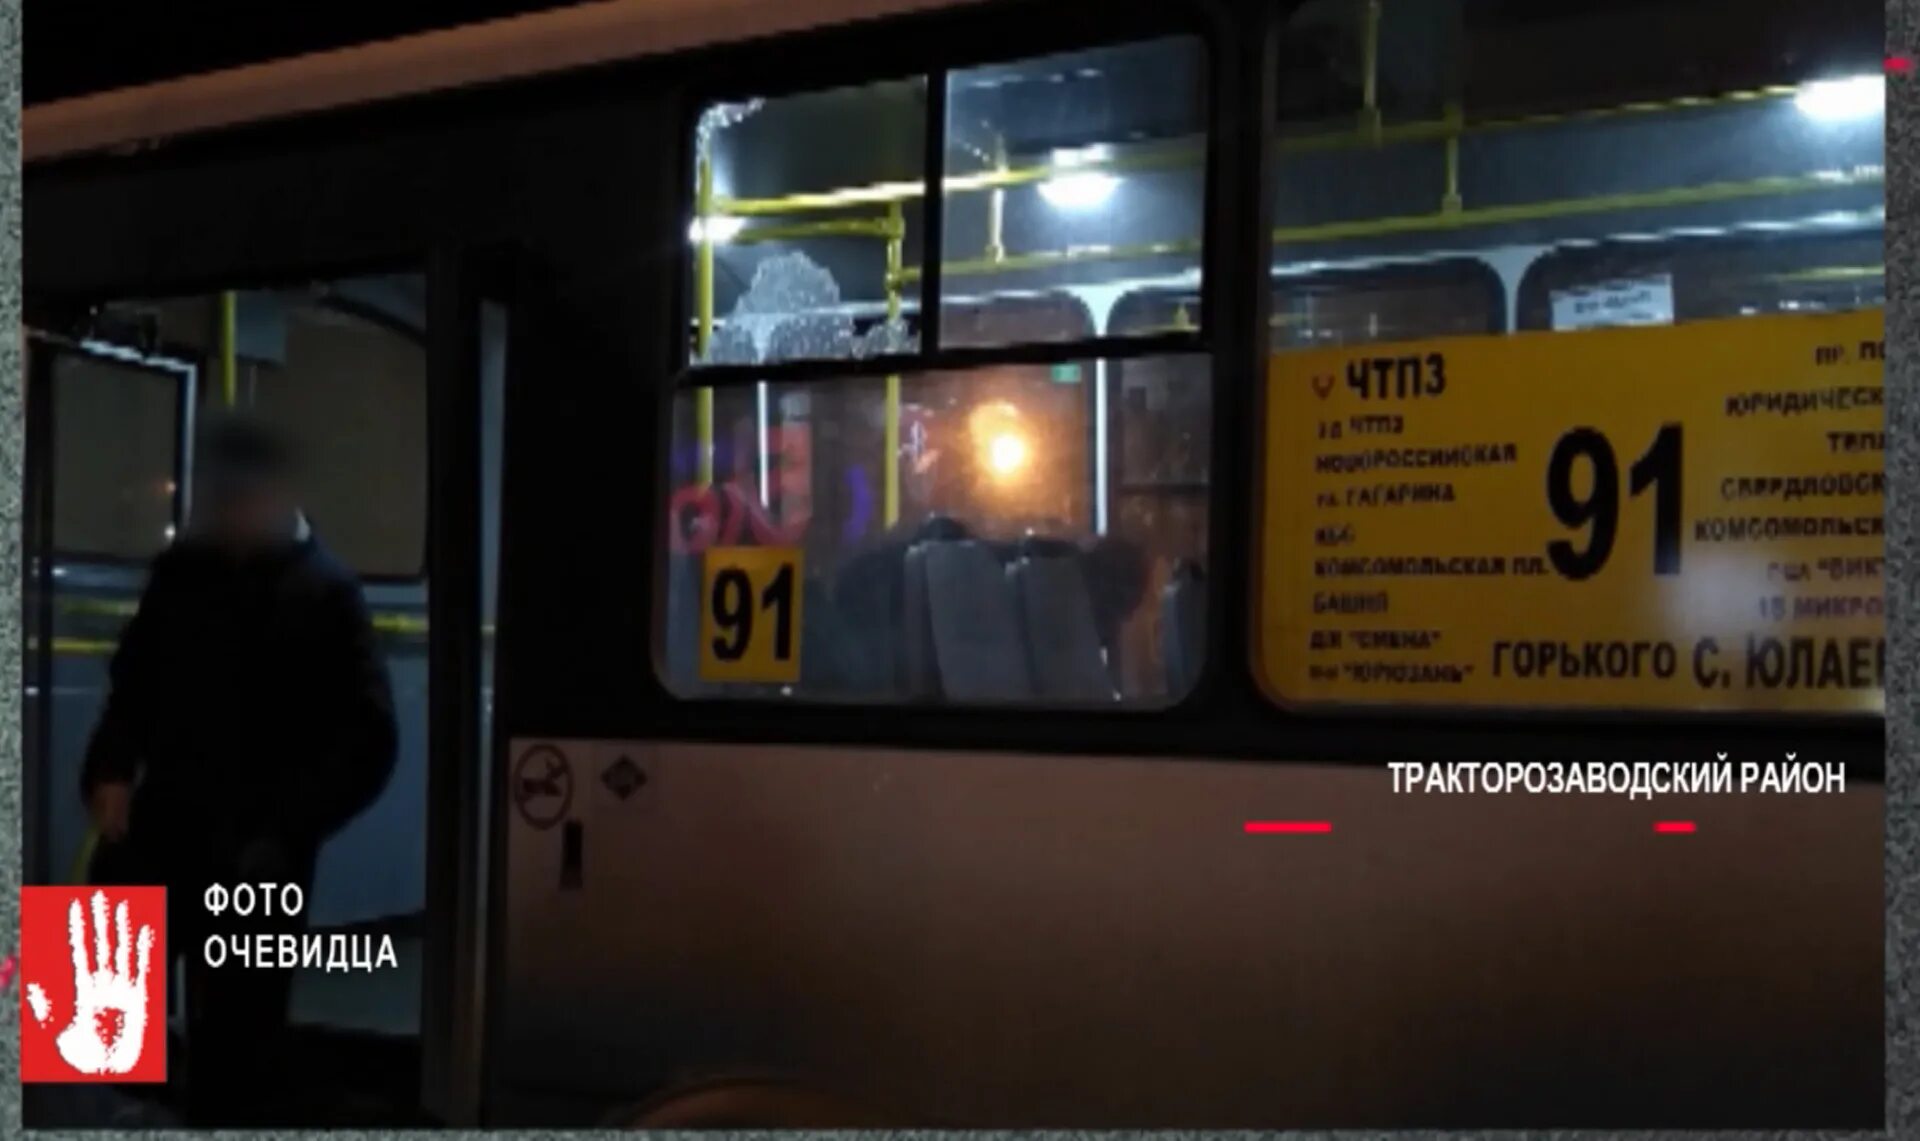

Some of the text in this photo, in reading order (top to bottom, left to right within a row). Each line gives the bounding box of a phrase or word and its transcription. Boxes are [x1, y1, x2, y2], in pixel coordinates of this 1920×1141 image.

[1346, 352, 1446, 400] ЧТПЗ
[1346, 482, 1456, 508] ГАГАРИНА
[1547, 422, 1683, 581] 91
[711, 561, 794, 662] 91
[1492, 641, 1677, 680] ГОРЬКОГО
[1693, 636, 1731, 690] С.
